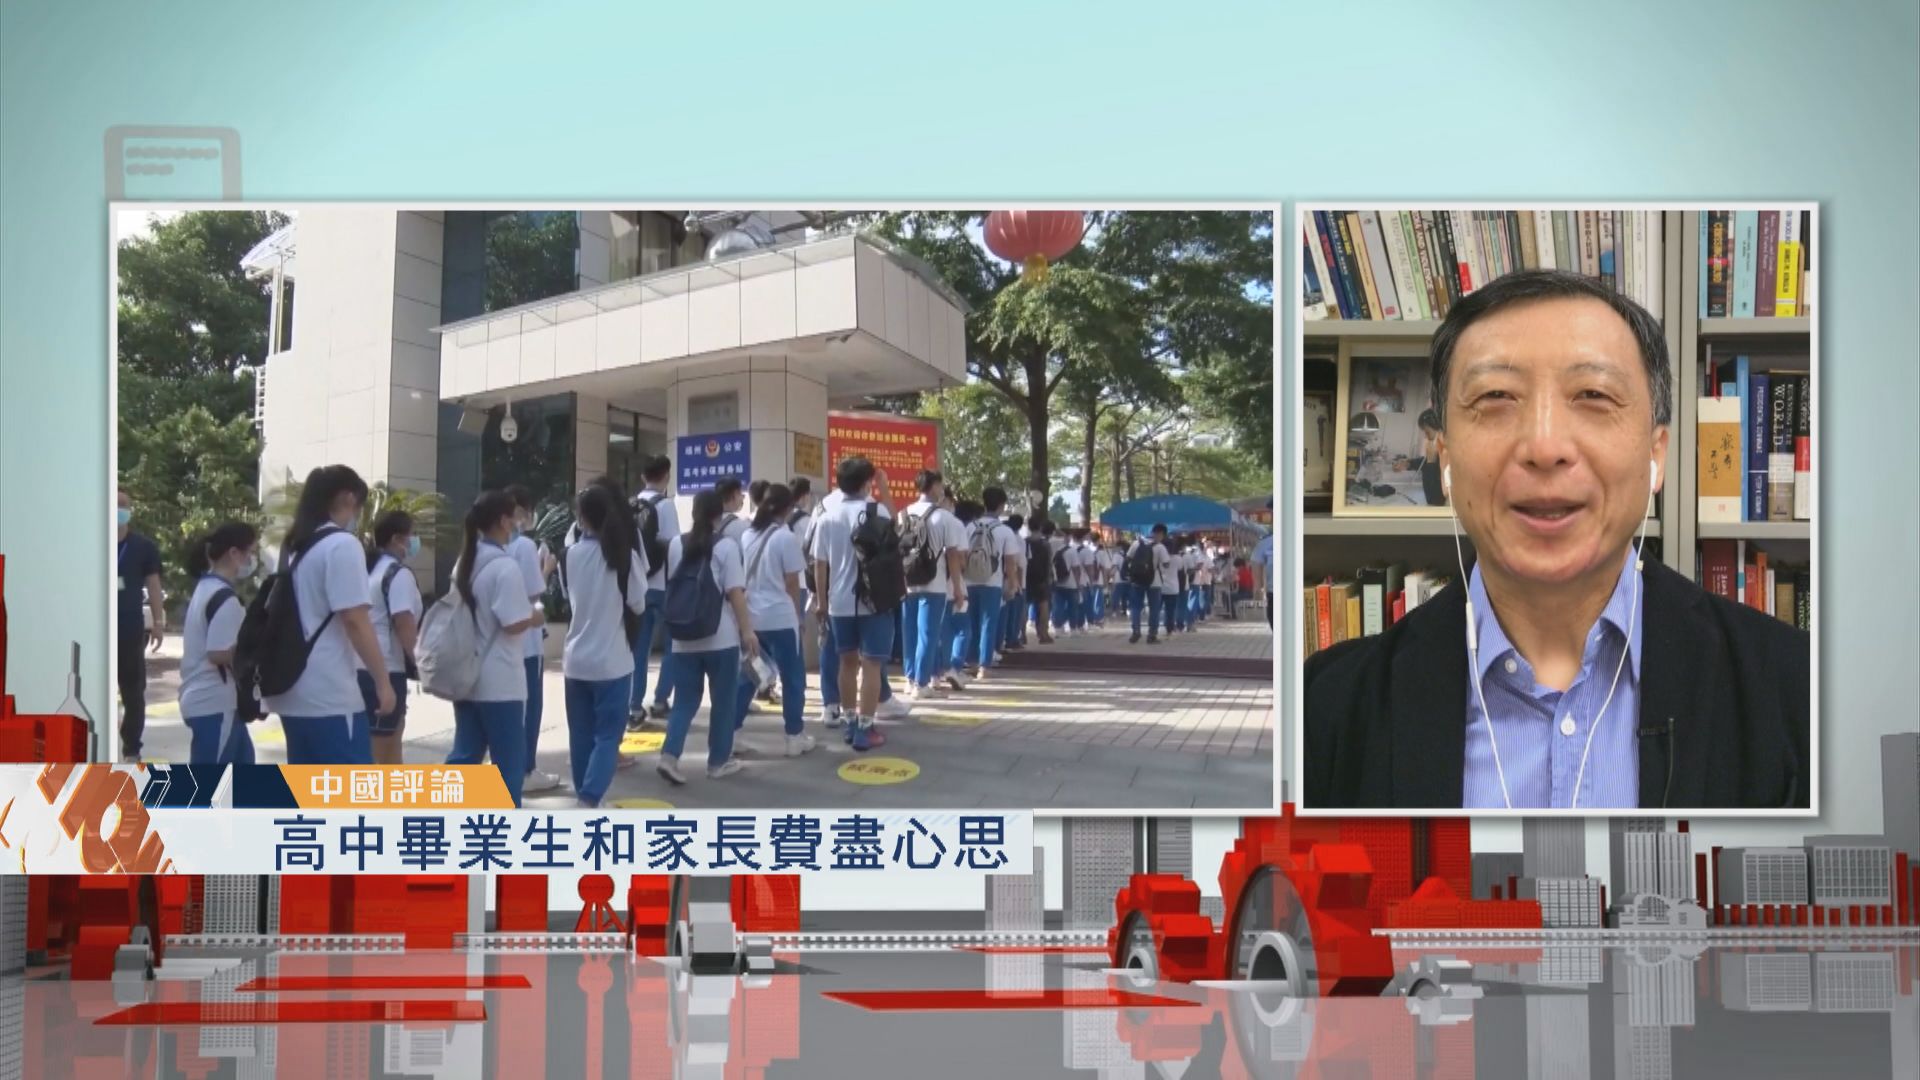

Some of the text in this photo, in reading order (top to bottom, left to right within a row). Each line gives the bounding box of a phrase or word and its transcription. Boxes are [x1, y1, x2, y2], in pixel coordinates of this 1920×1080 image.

[1773, 384, 1786, 446] WORLD
[724, 441, 742, 452] 公安
[683, 464, 744, 478] 高考安保服务站
